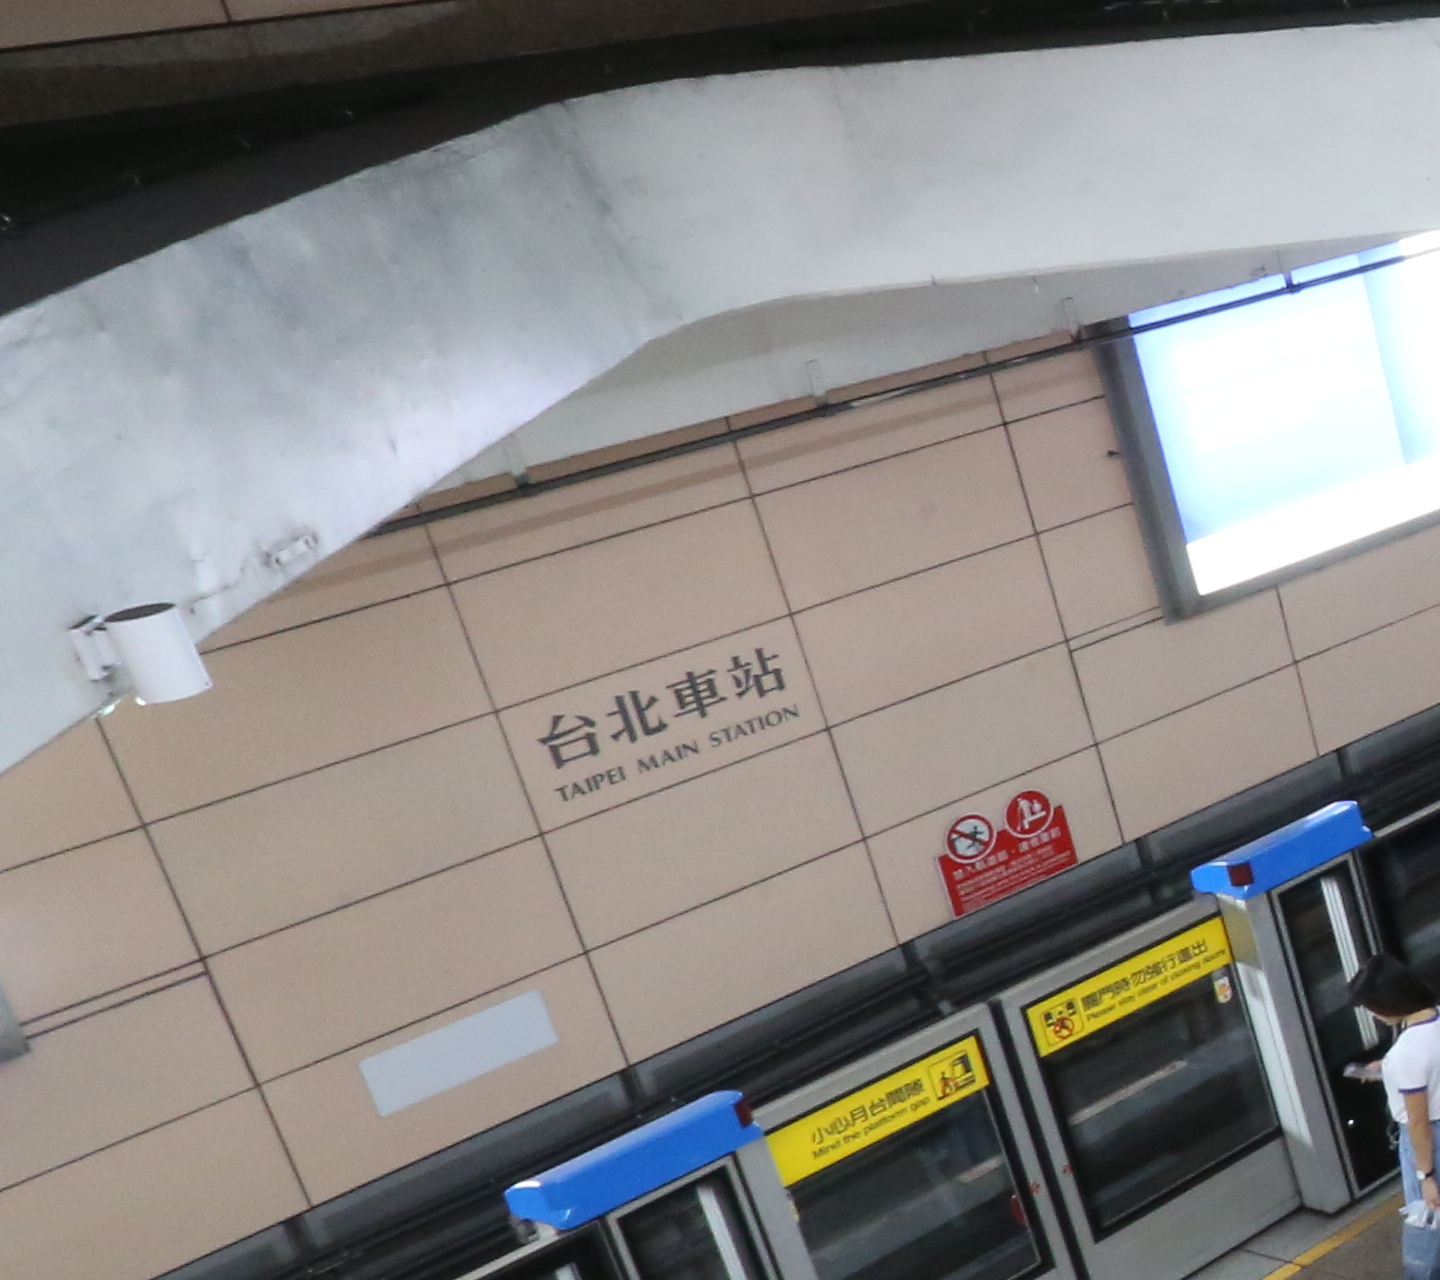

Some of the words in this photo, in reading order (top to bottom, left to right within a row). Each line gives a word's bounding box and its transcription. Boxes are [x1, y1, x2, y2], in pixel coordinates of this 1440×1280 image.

[537, 648, 786, 769] 台北車站
[555, 766, 627, 802] TAIPEI
[637, 740, 699, 774] MAIN
[709, 704, 800, 748] STATION
[812, 1078, 924, 1144] 小心月台間隙
[812, 1138, 841, 1159] Mind
[844, 1129, 861, 1143] the
[863, 1105, 908, 1136] platform
[910, 1096, 931, 1112] gap
